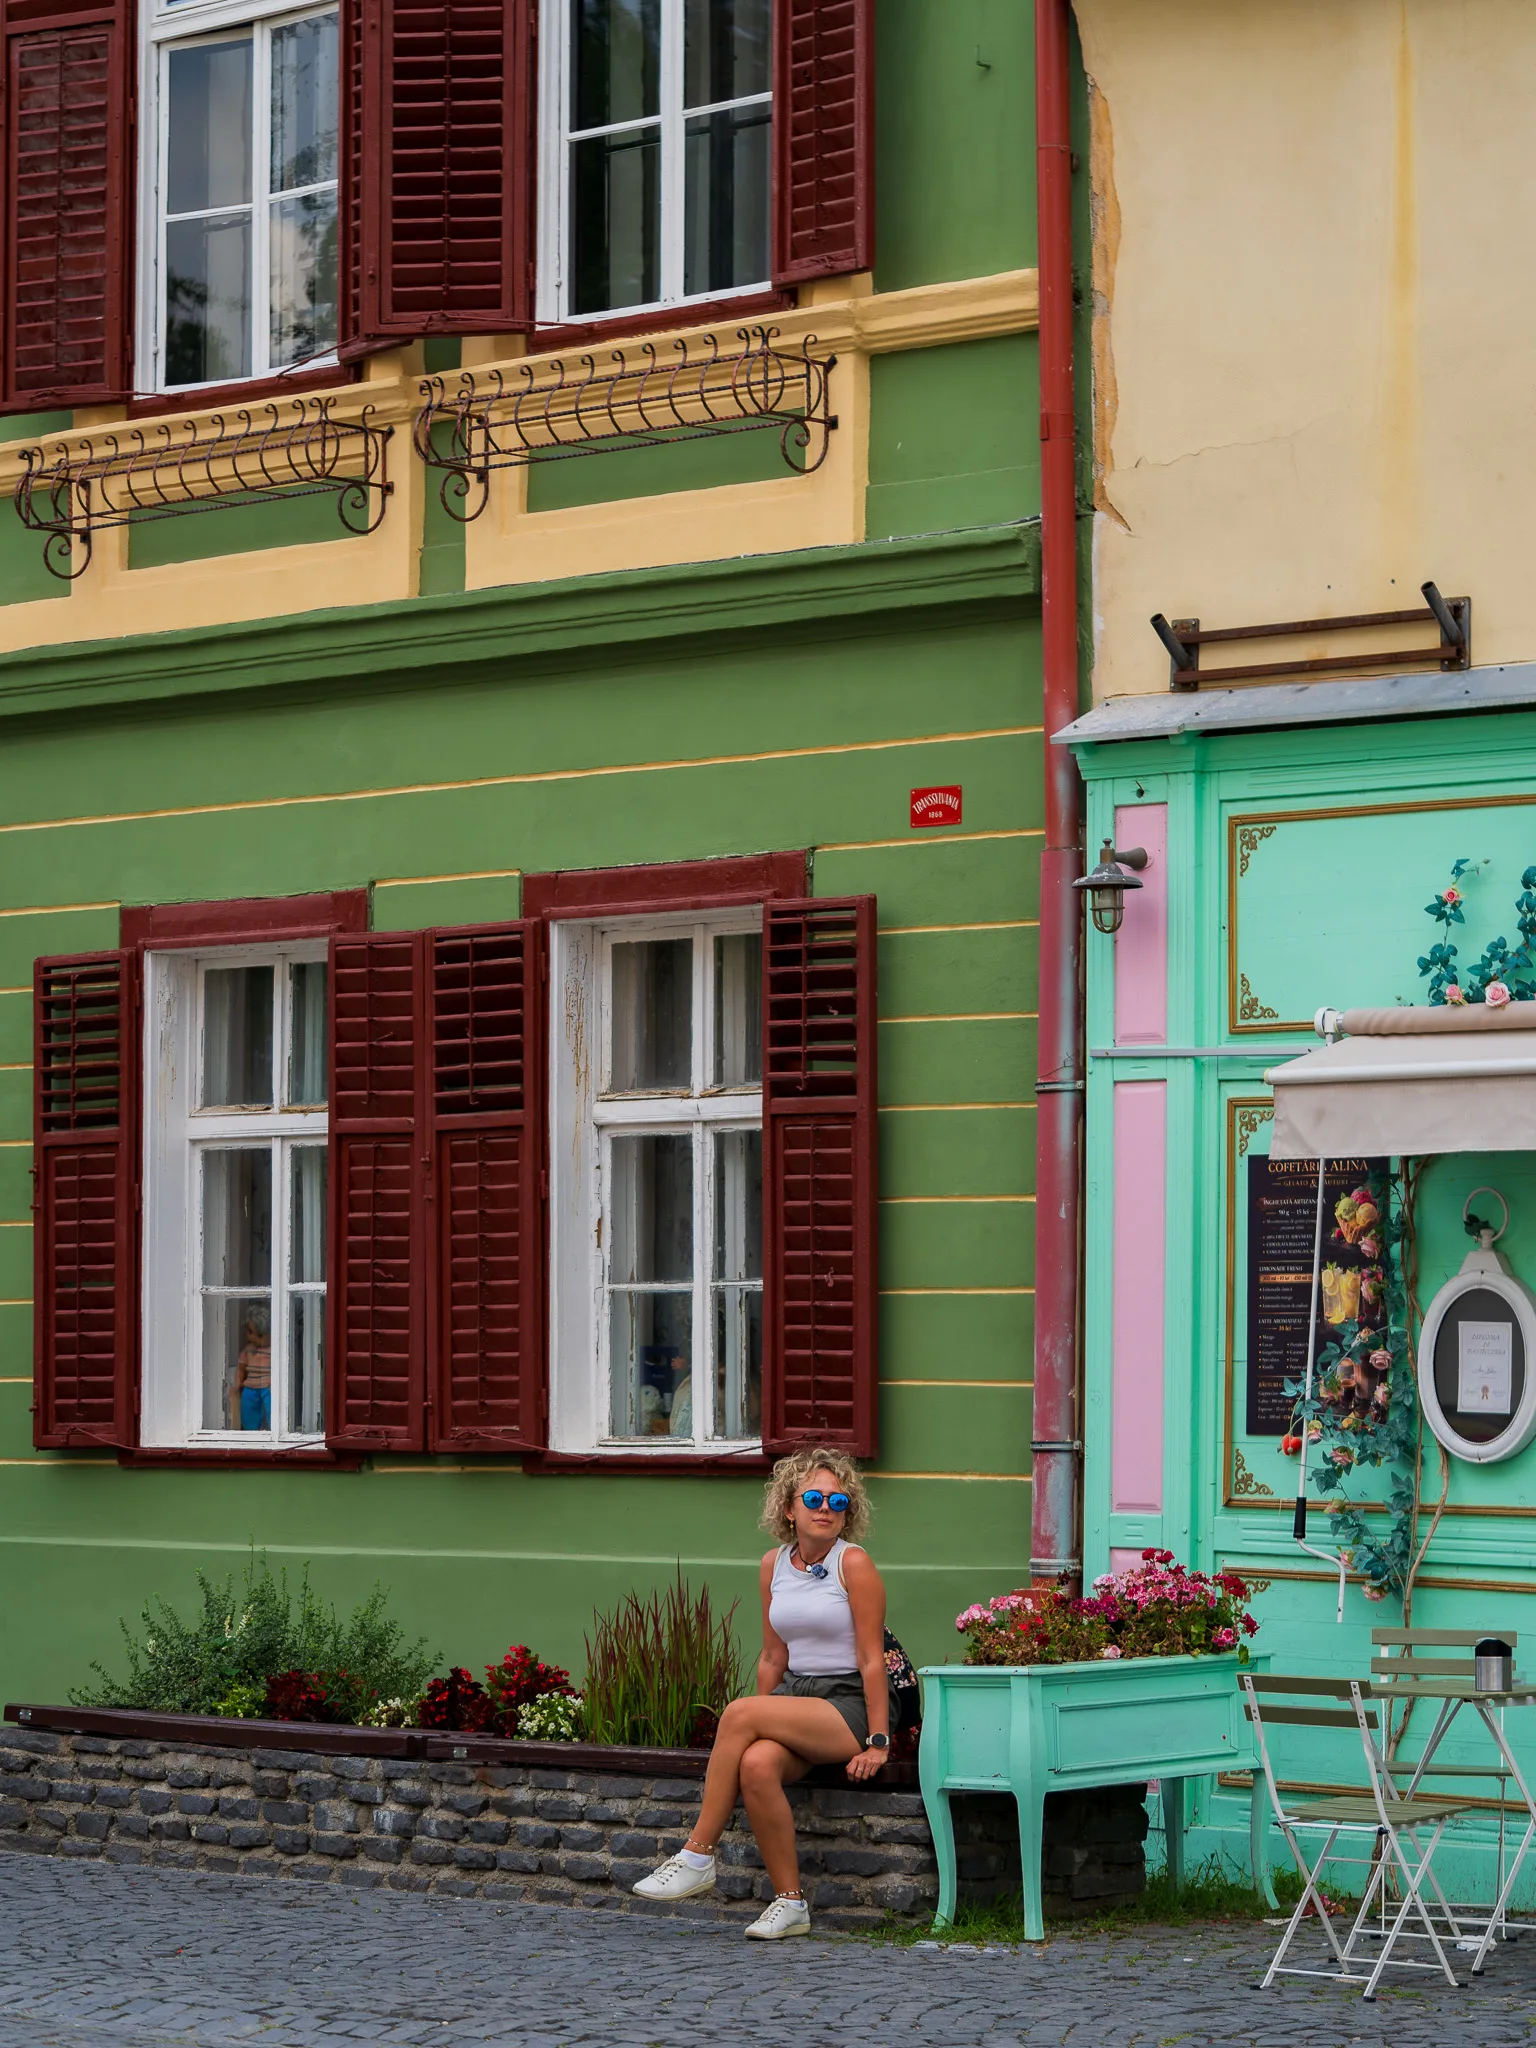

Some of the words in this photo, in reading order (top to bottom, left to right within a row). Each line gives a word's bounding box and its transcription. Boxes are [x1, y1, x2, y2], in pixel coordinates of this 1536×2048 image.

[928, 810, 943, 819] 1868
[1267, 1160, 1327, 1173] COFETĂRI
[1330, 1159, 1368, 1172] ALINA
